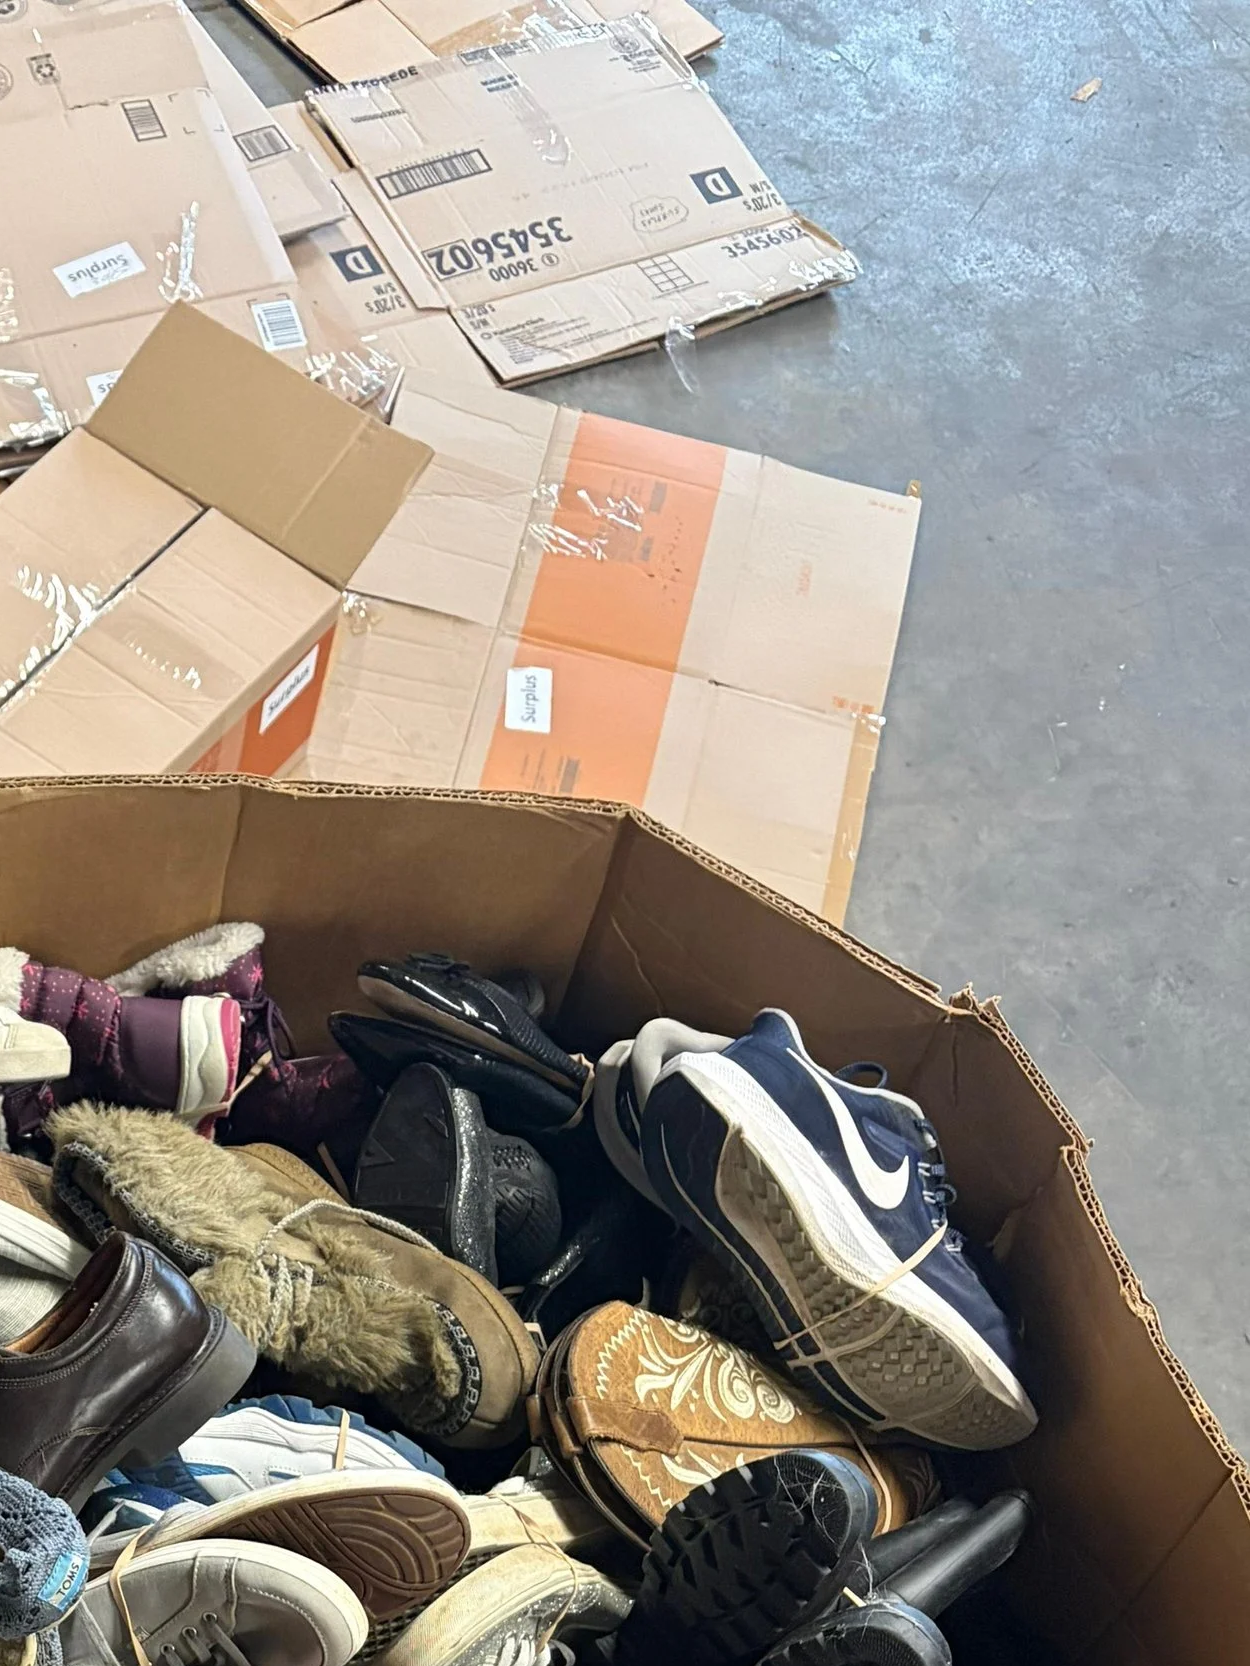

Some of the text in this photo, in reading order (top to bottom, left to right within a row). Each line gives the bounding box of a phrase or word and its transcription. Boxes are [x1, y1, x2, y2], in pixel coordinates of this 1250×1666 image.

[704, 172, 732, 197] D
[749, 180, 772, 195] S/M
[427, 216, 573, 276] 3545602
[720, 221, 809, 260] 3545602
[67, 254, 129, 283] Surplus
[345, 250, 373, 275] D
[489, 258, 539, 281] 36000
[267, 665, 311, 716] Surplus
[521, 674, 538, 724] Surplus
[56, 1563, 80, 1596] TOMS
